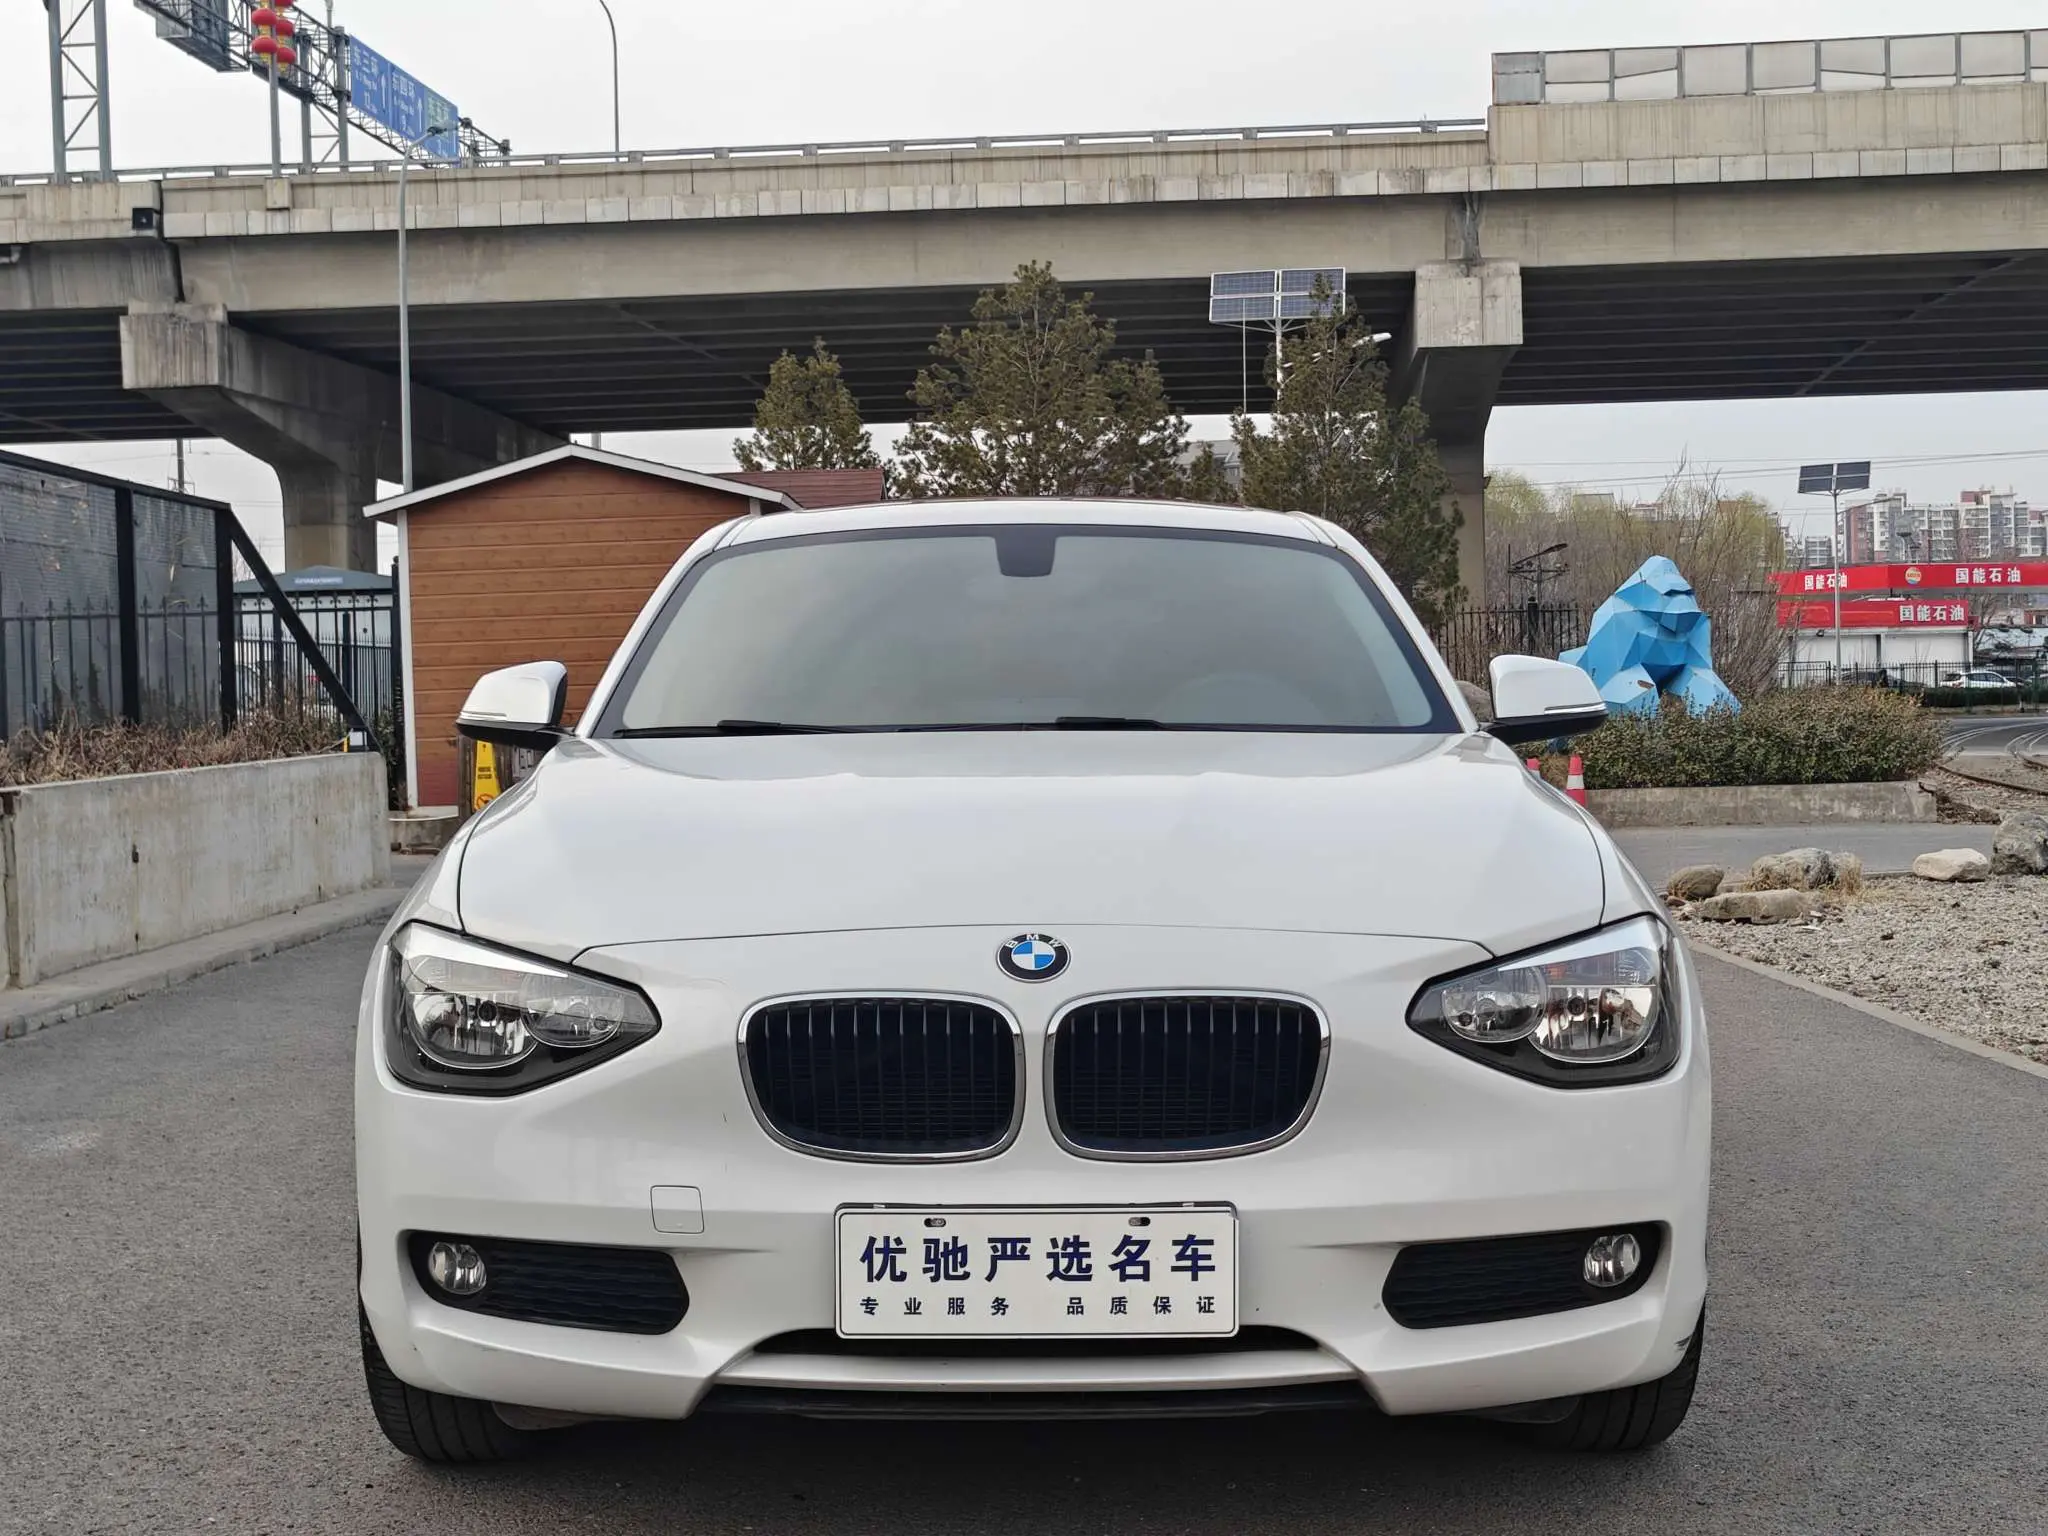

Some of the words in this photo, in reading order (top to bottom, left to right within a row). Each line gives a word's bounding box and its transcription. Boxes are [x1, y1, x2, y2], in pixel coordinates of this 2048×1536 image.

[1804, 572, 1848, 591] 国能石油
[1955, 567, 2021, 584] 国能石油
[1900, 604, 1964, 621] 国能石油
[1005, 933, 1062, 949] BMW
[859, 1234, 1216, 1283] 优驰严选名车
[860, 1296, 1010, 1316] 专业服务
[1066, 1295, 1216, 1315] 品质保证
